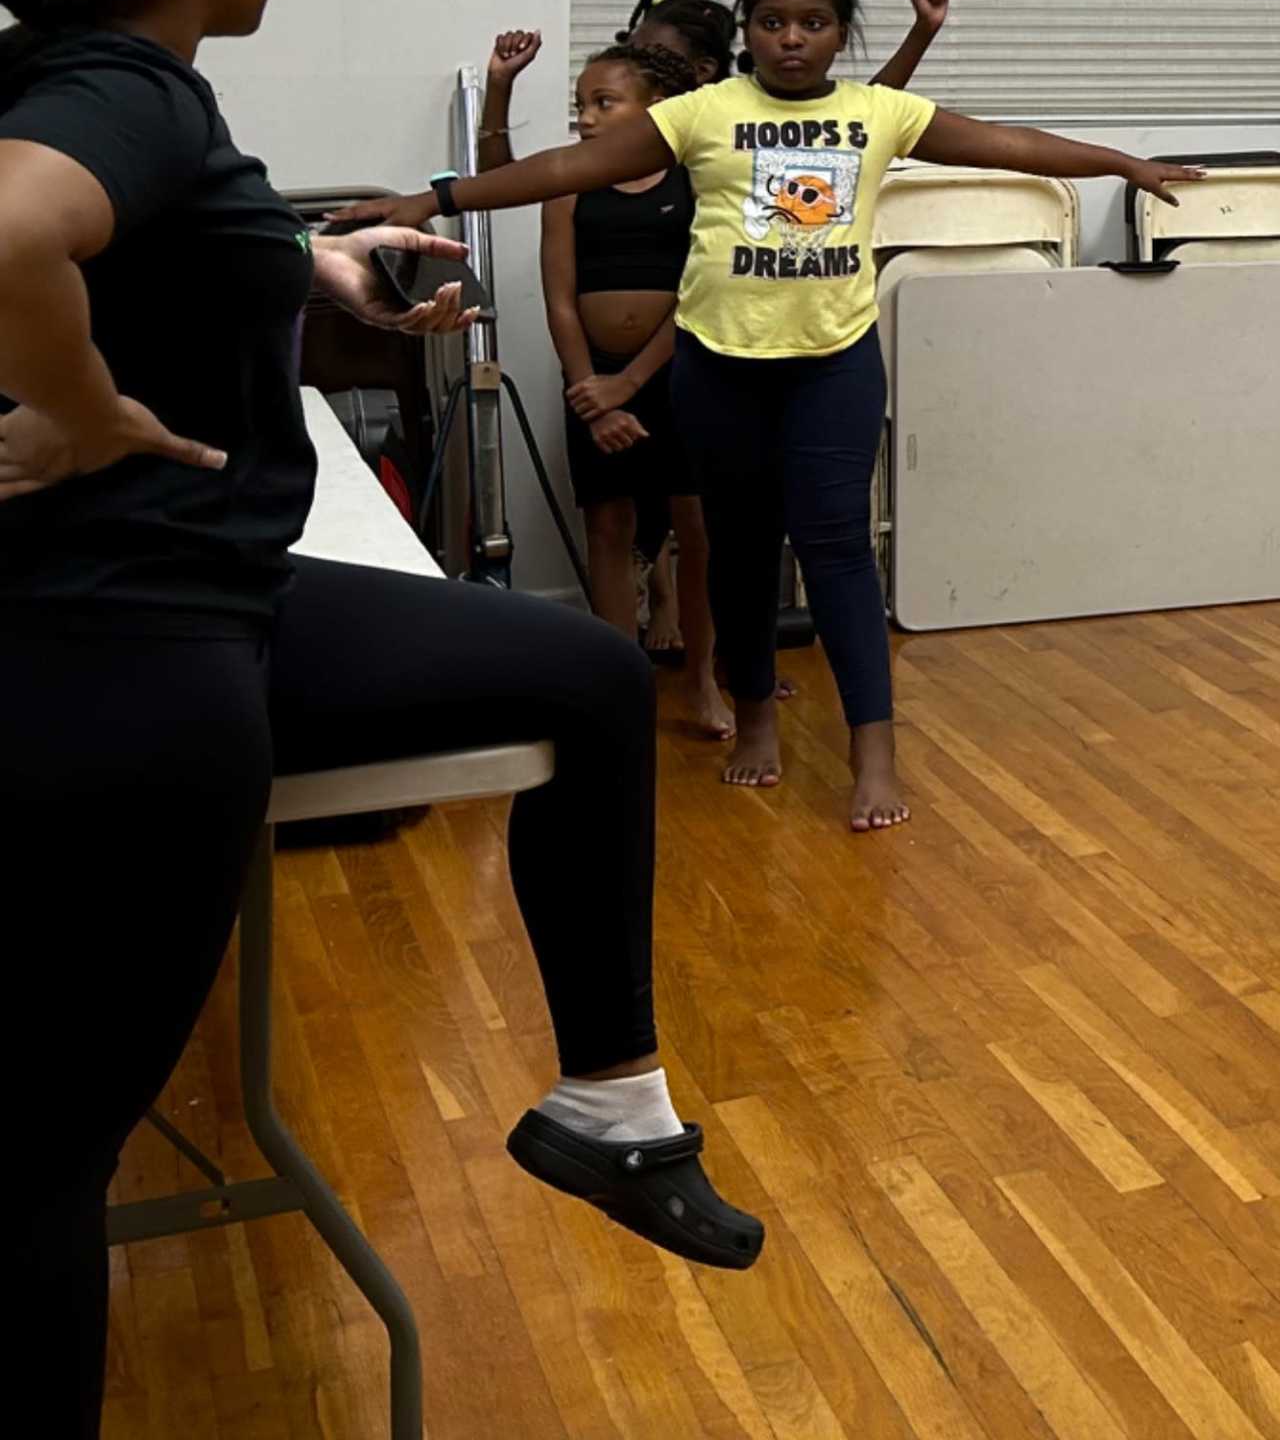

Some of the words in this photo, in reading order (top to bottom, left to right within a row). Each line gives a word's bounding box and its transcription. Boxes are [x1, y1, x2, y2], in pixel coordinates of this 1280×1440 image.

[734, 120, 842, 149] HOOPS
[847, 121, 868, 148] &
[732, 245, 861, 278] DREAMS
